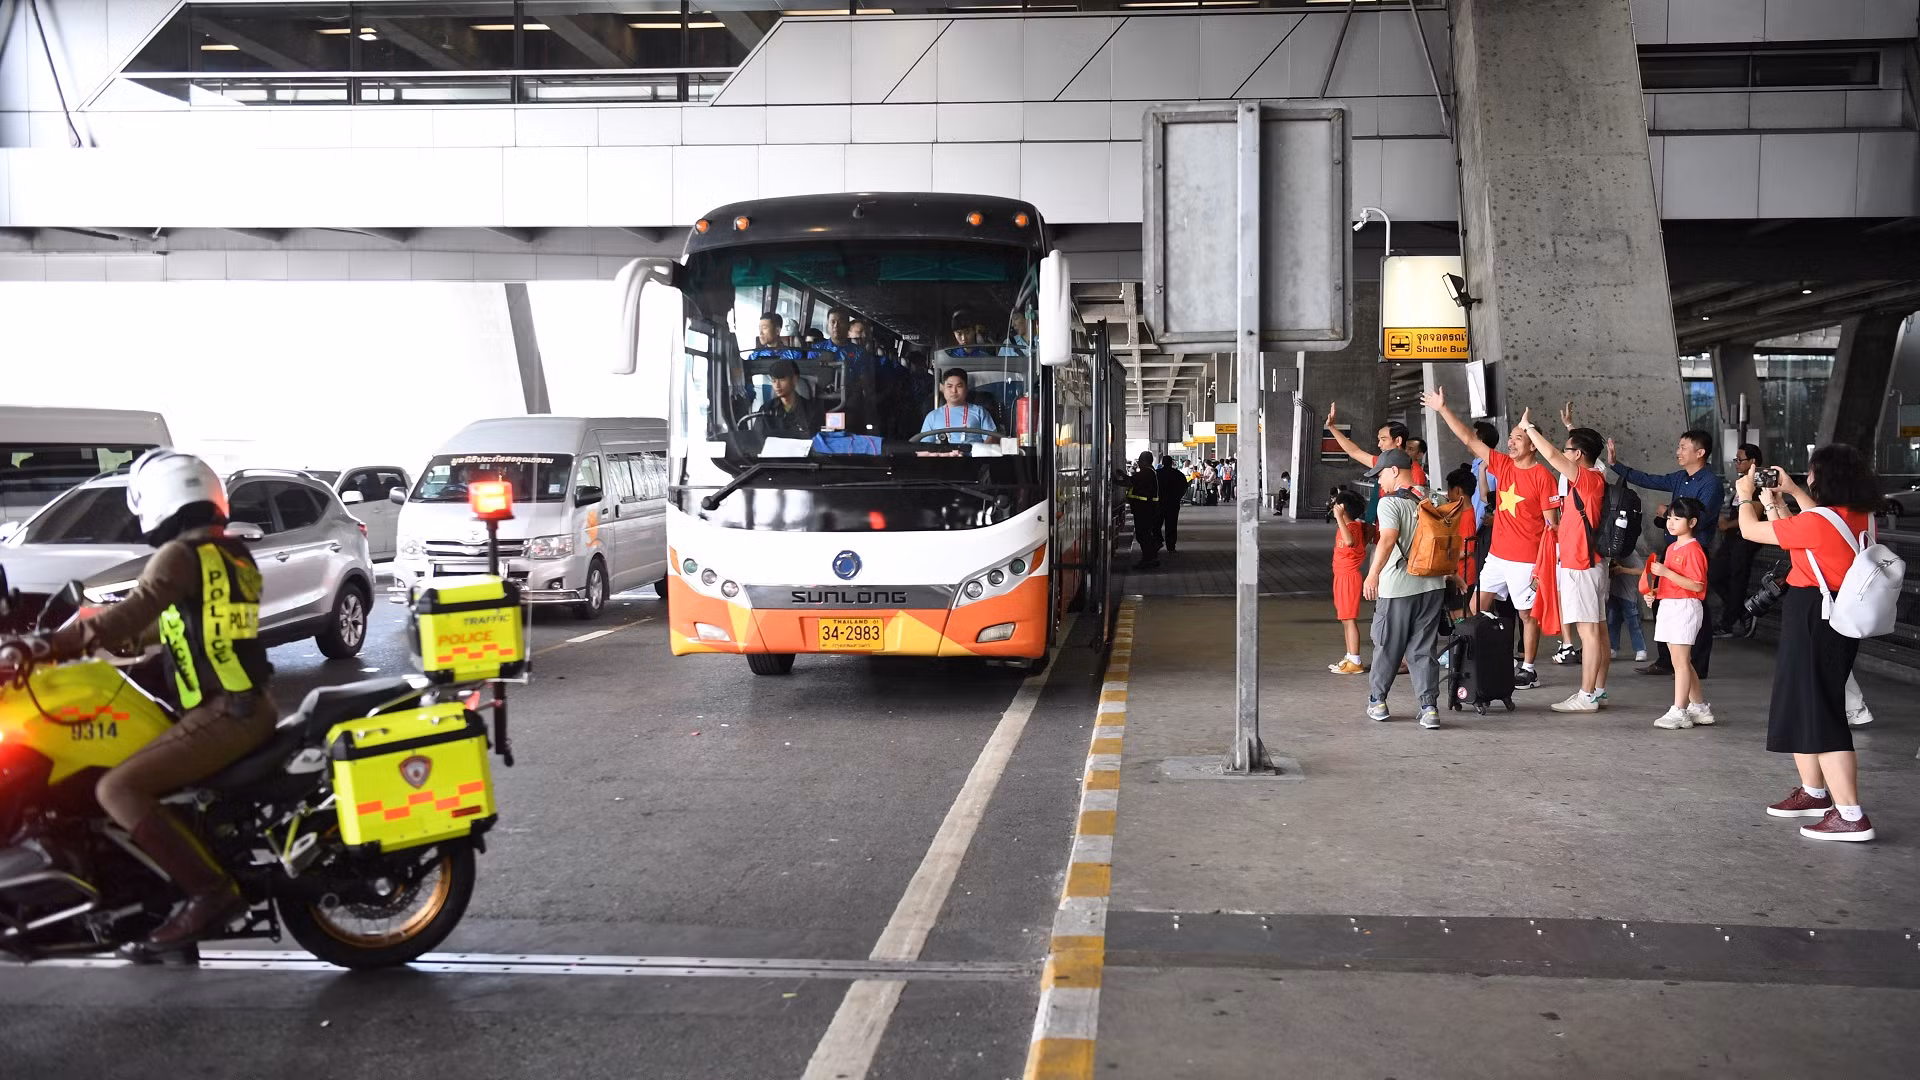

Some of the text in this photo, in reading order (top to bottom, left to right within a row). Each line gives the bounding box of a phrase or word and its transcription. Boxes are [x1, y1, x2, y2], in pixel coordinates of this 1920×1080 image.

[1416, 331, 1467, 345] จุดจอดรถเ
[1416, 345, 1448, 353] Shuttle
[791, 591, 907, 604] SUNLONG
[208, 569, 231, 665] POLICE
[464, 614, 510, 625] TRAFFIC
[438, 630, 493, 646] POLICE
[822, 625, 880, 641] 34-2983
[70, 721, 117, 741] 9314
